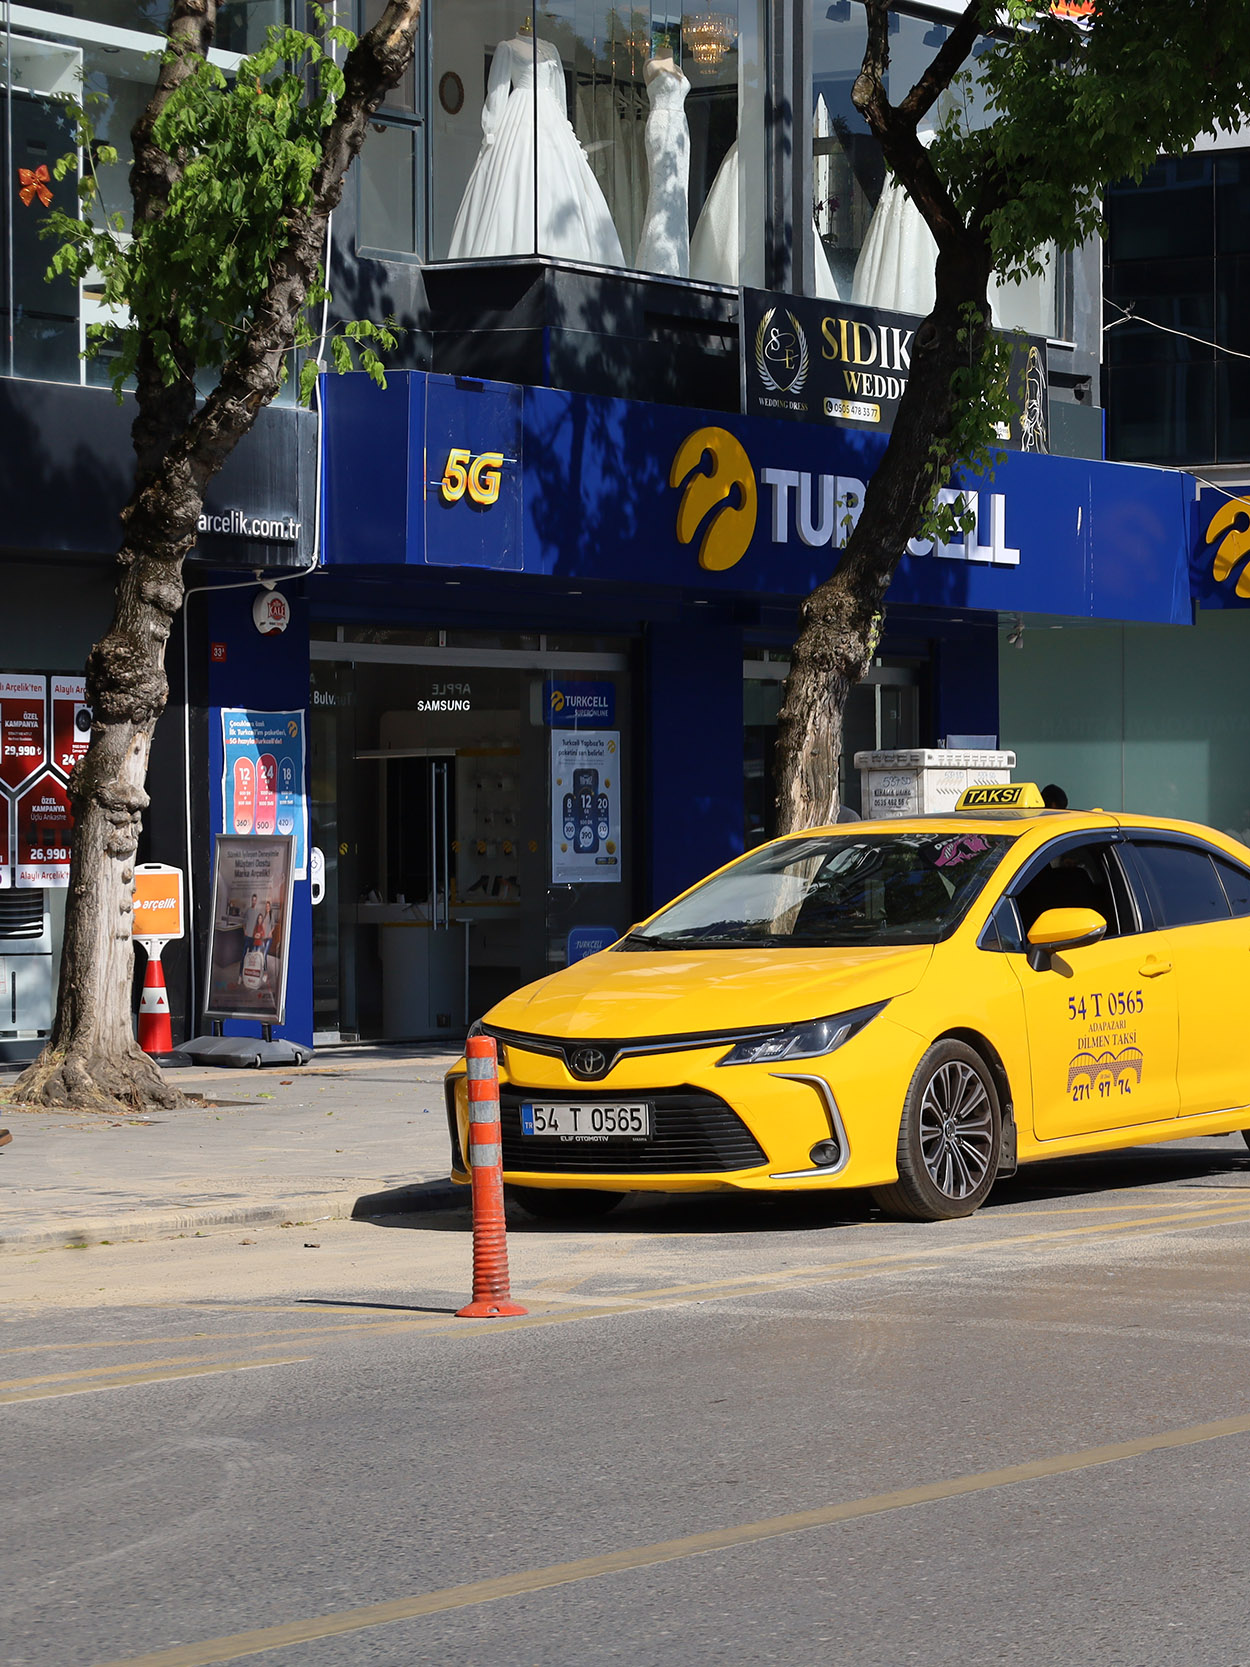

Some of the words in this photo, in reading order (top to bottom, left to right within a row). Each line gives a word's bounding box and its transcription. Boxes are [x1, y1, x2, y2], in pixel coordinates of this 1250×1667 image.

[821, 316, 914, 371] SIDIK
[843, 370, 909, 401] WEDDI
[758, 397, 788, 409] WEDDING
[442, 448, 504, 505] 5G
[198, 510, 302, 539] arcelik.com.tr
[417, 700, 471, 711] SAMSUNG
[565, 696, 609, 708] TURKCELL
[23, 711, 39, 721] ÖZEL
[4, 720, 39, 729] KAMPANYA
[4, 745, 36, 757] 29,990
[239, 767, 251, 781] 12
[260, 765, 274, 779] 24
[282, 767, 292, 781] 18
[41, 796, 56, 805] ÖZEL
[581, 794, 592, 809] 12
[967, 788, 1021, 804] TAKSİ
[597, 798, 608, 809] 20
[30, 848, 67, 862] 26,990
[142, 898, 176, 911] arçelik
[1068, 996, 1087, 1020] 54
[1090, 993, 1103, 1017] T
[1107, 990, 1144, 1016] 0565
[1088, 1020, 1127, 1032] ADAPAZARI
[1077, 1034, 1111, 1050] DİLMEN
[1111, 1029, 1137, 1046] TAKSİ
[1072, 1083, 1090, 1102] 271
[1098, 1080, 1111, 1098] 97
[1118, 1078, 1131, 1095] 74
[524, 1121, 533, 1129] TR
[534, 1108, 559, 1132] 54
[569, 1108, 581, 1132] T
[591, 1107, 642, 1132] 0565
